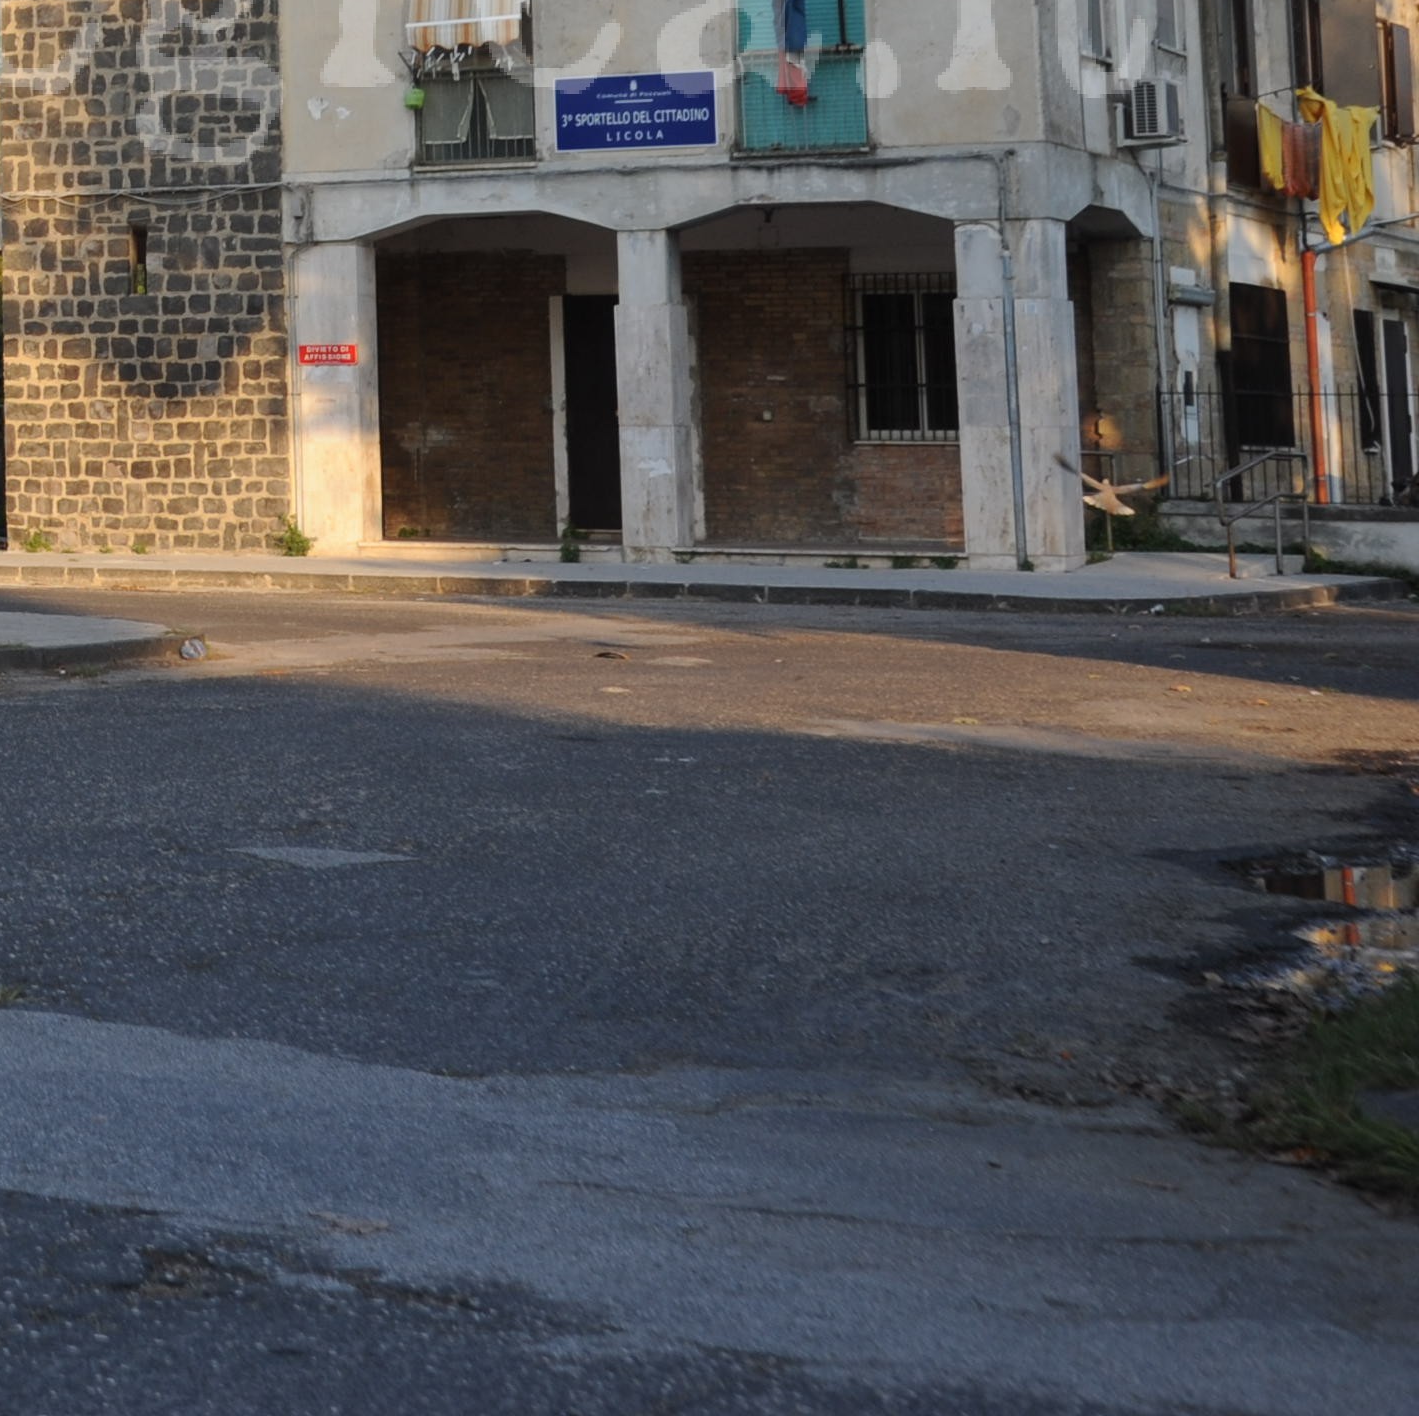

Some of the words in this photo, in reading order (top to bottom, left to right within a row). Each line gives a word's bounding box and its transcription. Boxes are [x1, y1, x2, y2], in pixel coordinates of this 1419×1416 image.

[574, 110, 631, 127] SPORTELLO
[632, 109, 652, 124] DEL
[653, 107, 710, 123] CITTADINO
[606, 130, 664, 142] LICOLA
